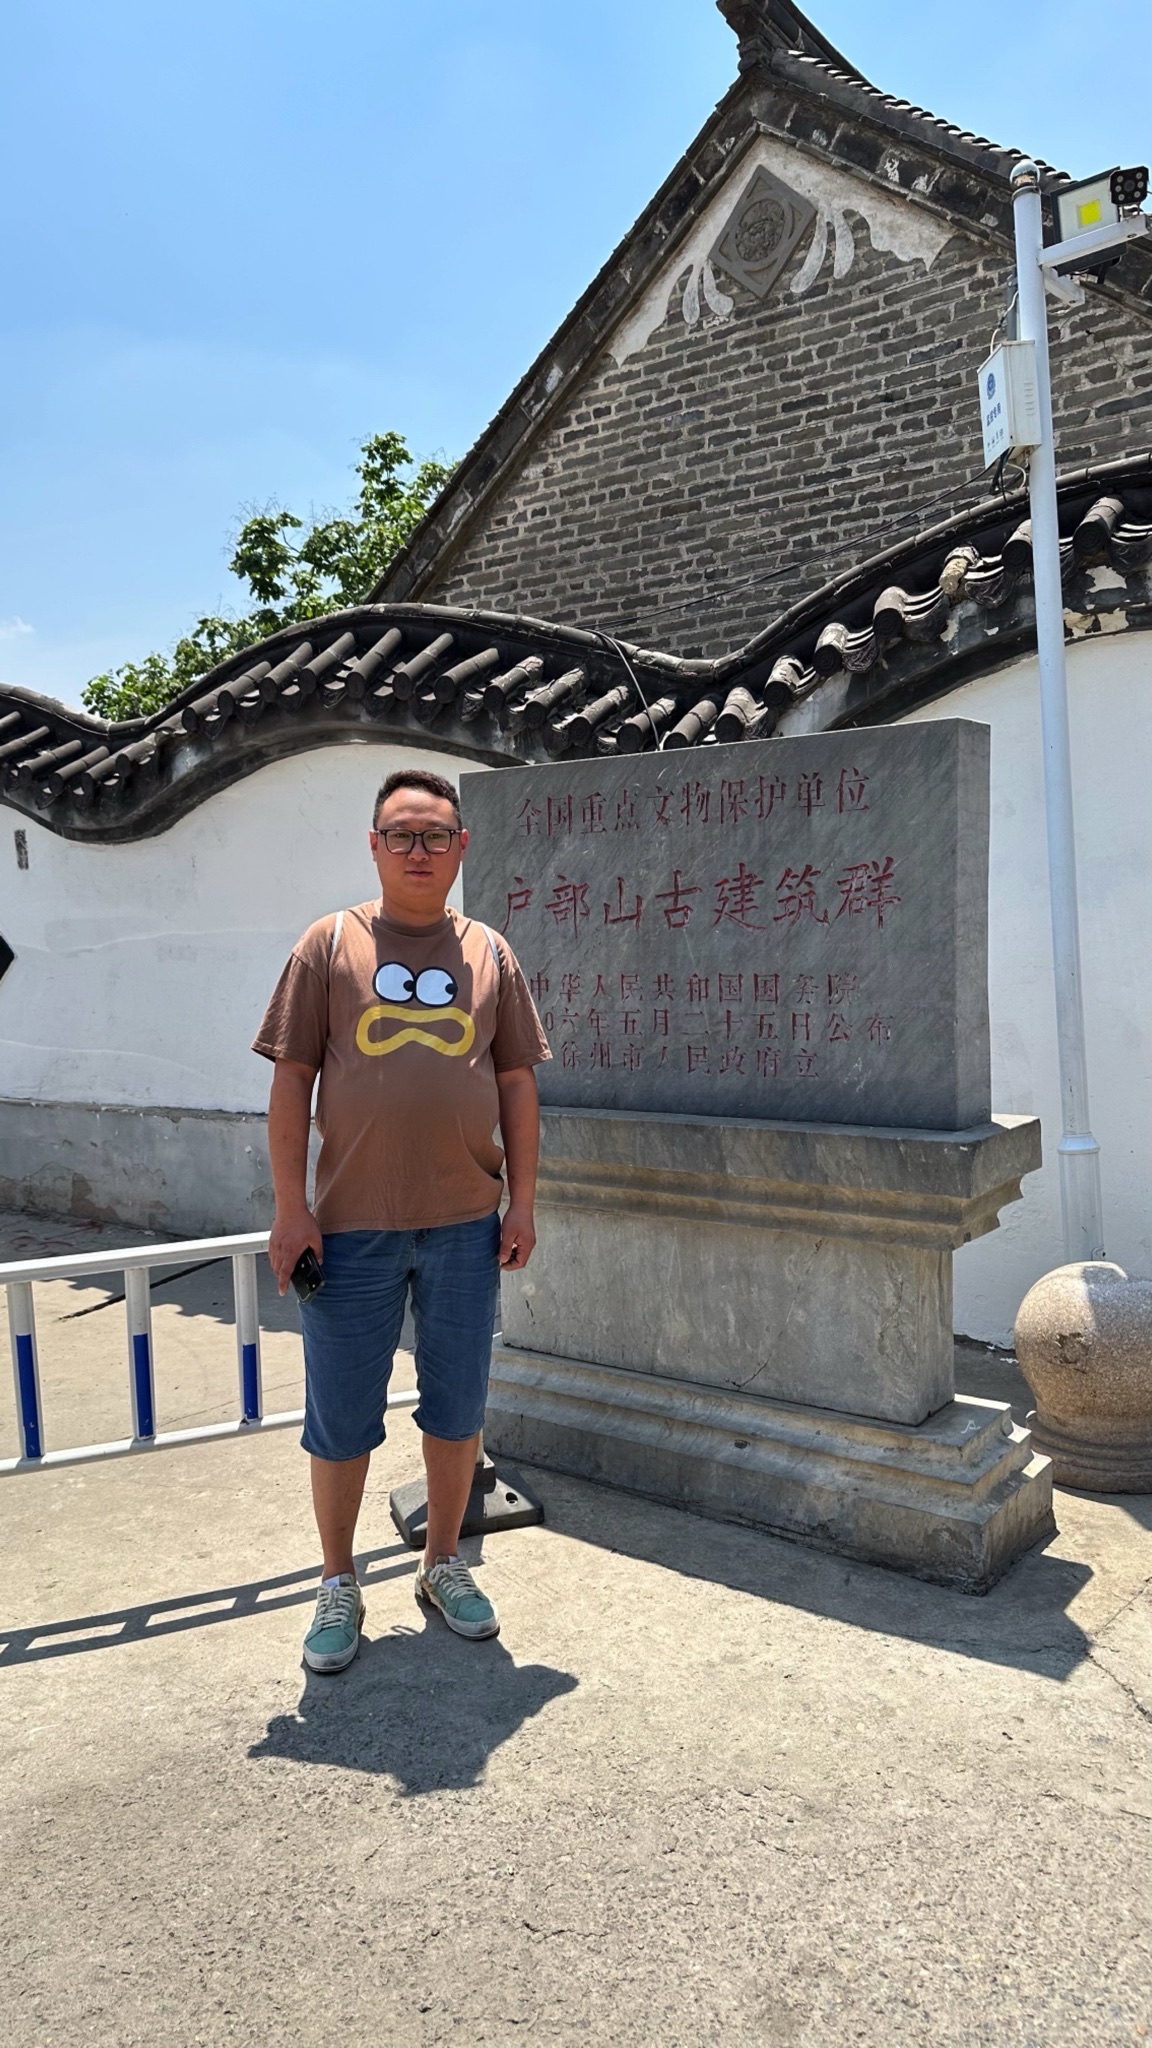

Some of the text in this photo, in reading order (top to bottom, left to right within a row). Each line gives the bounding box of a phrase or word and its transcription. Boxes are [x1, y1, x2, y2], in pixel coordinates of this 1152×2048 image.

[516, 767, 870, 838] 全国重点文物保护单位
[501, 856, 901, 939] 户部山古建筑群
[529, 972, 858, 1005] 中华人民共和国国务院
[560, 1041, 820, 1078] 徐州市人民政府立
